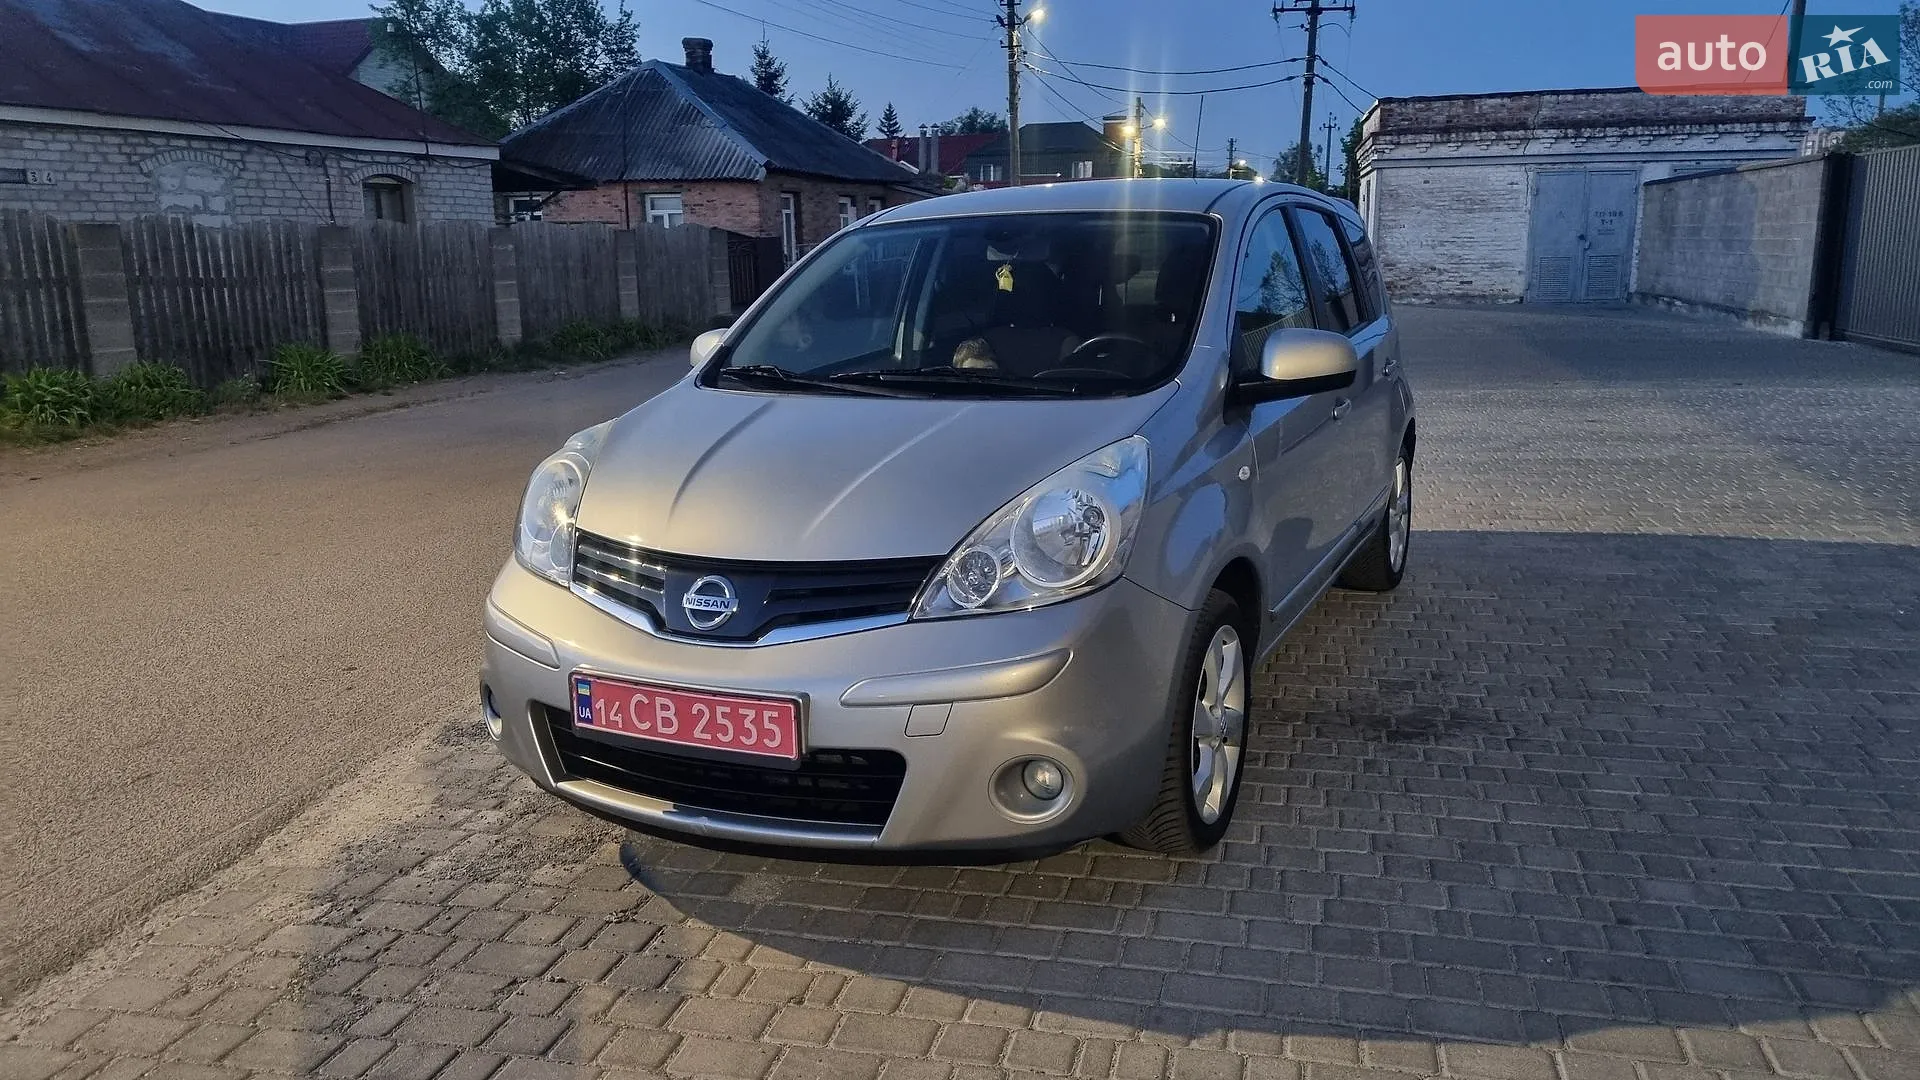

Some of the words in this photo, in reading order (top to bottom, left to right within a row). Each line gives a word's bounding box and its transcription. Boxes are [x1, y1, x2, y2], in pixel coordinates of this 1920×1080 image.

[685, 596, 730, 609] NISSAN
[578, 705, 592, 720] UA
[691, 703, 782, 748] 2535
